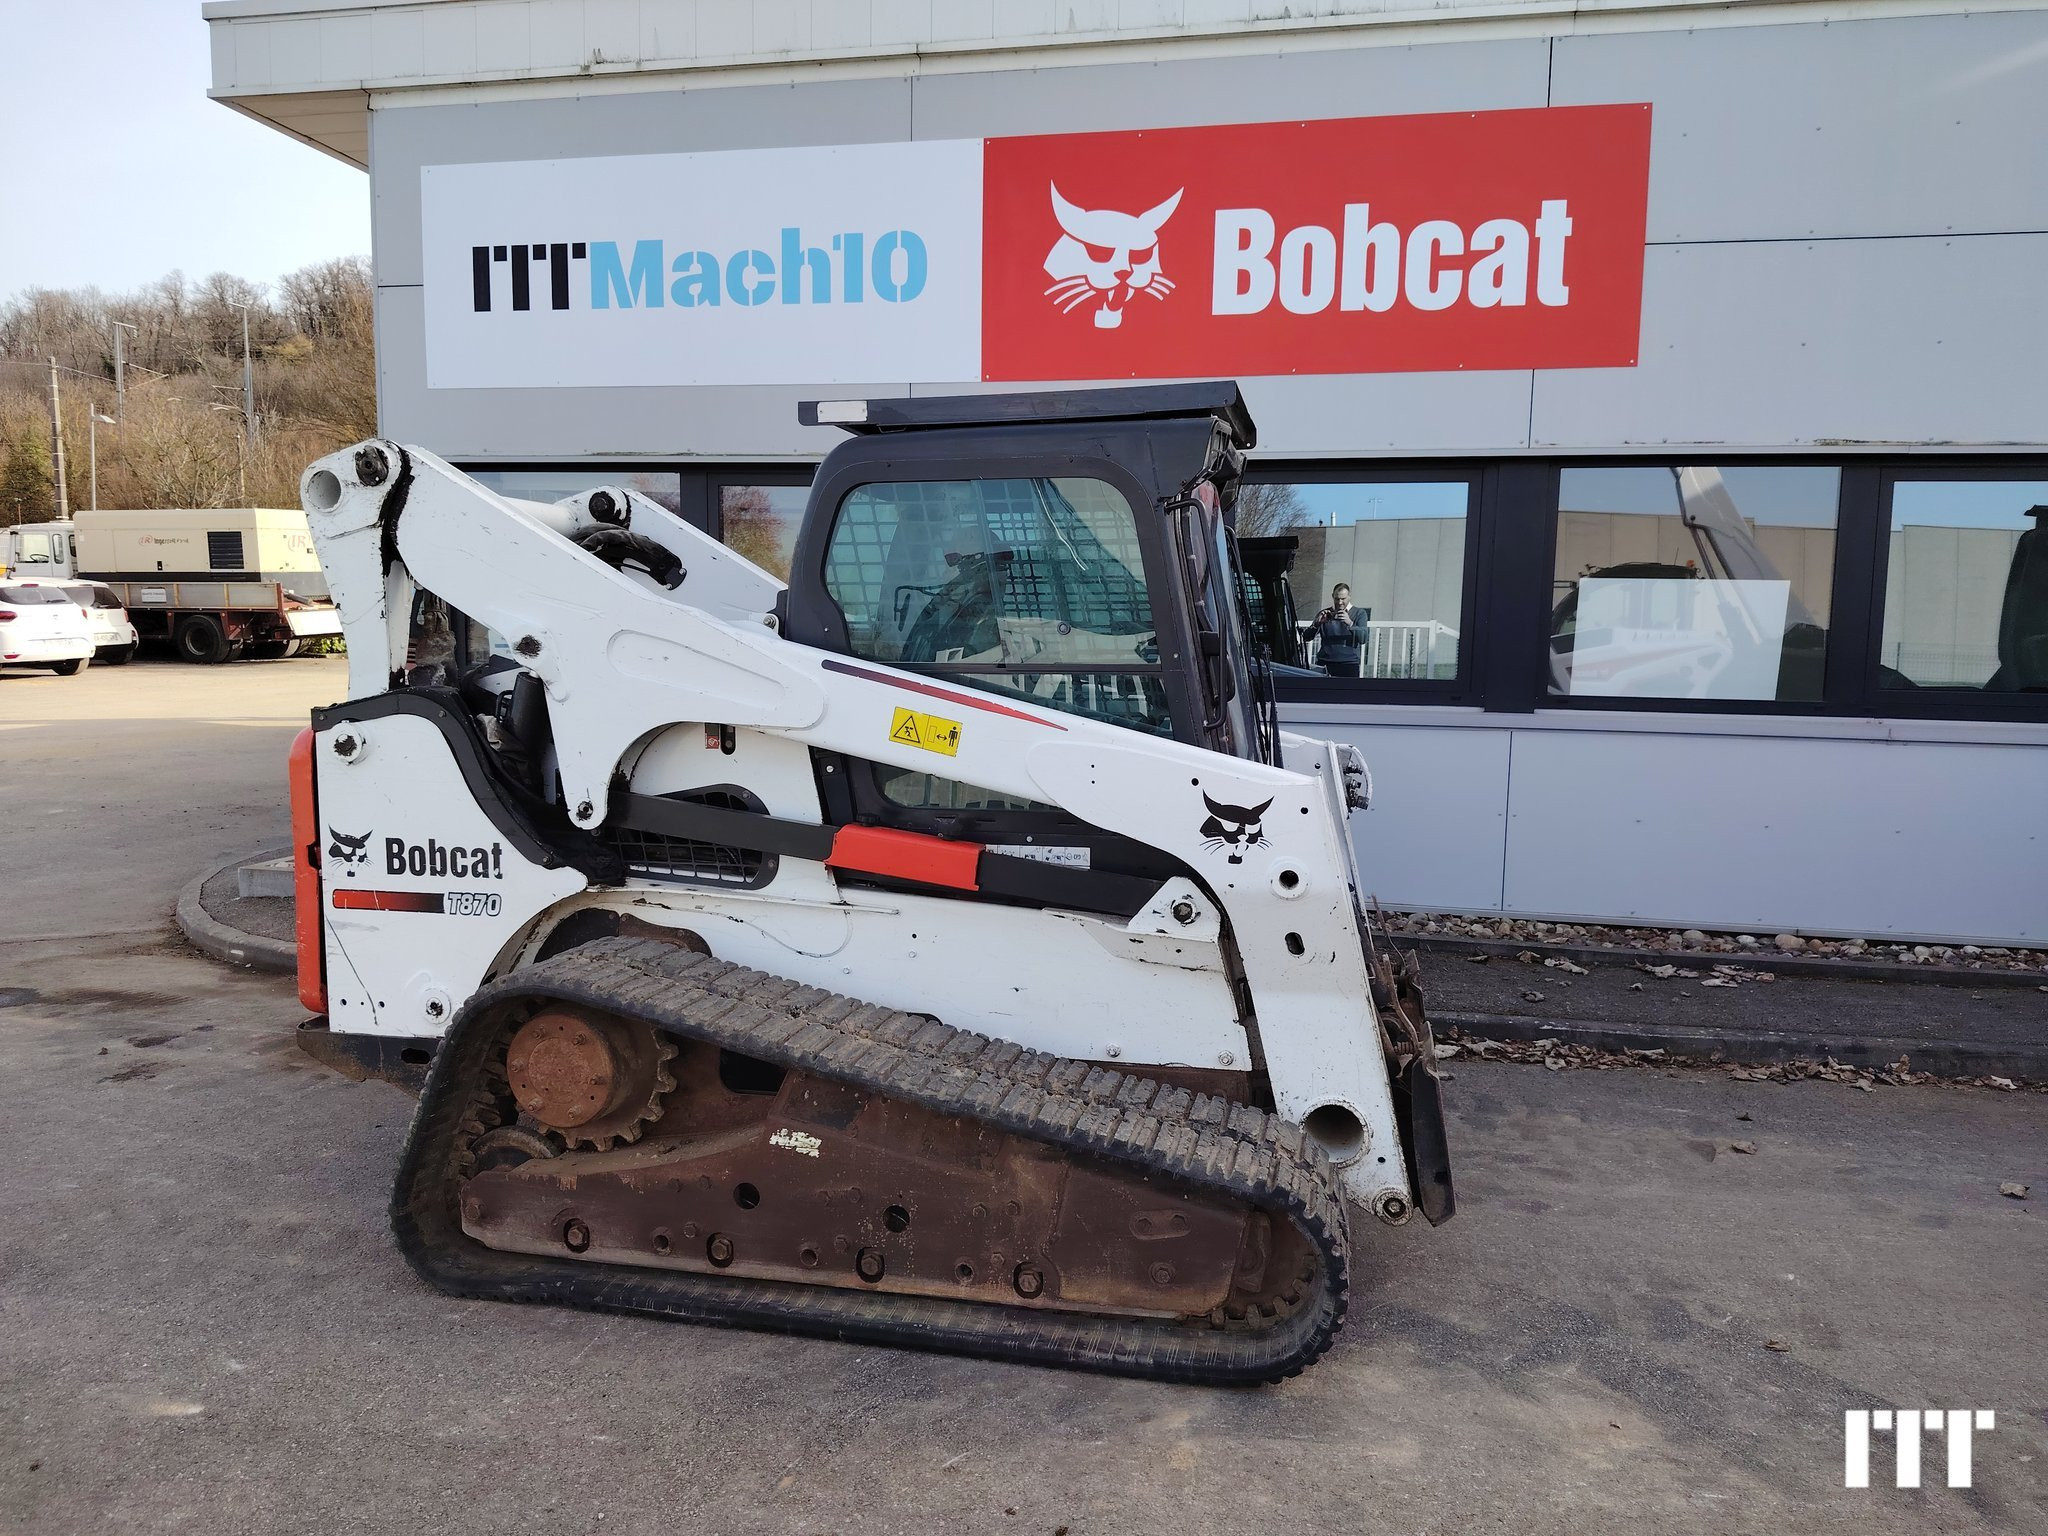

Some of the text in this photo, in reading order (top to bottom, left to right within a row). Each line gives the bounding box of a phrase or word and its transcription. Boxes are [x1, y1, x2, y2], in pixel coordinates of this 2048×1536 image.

[1211, 199, 1573, 316] Bobcat
[385, 837, 503, 880] Bobcat
[448, 891, 502, 917] T870
